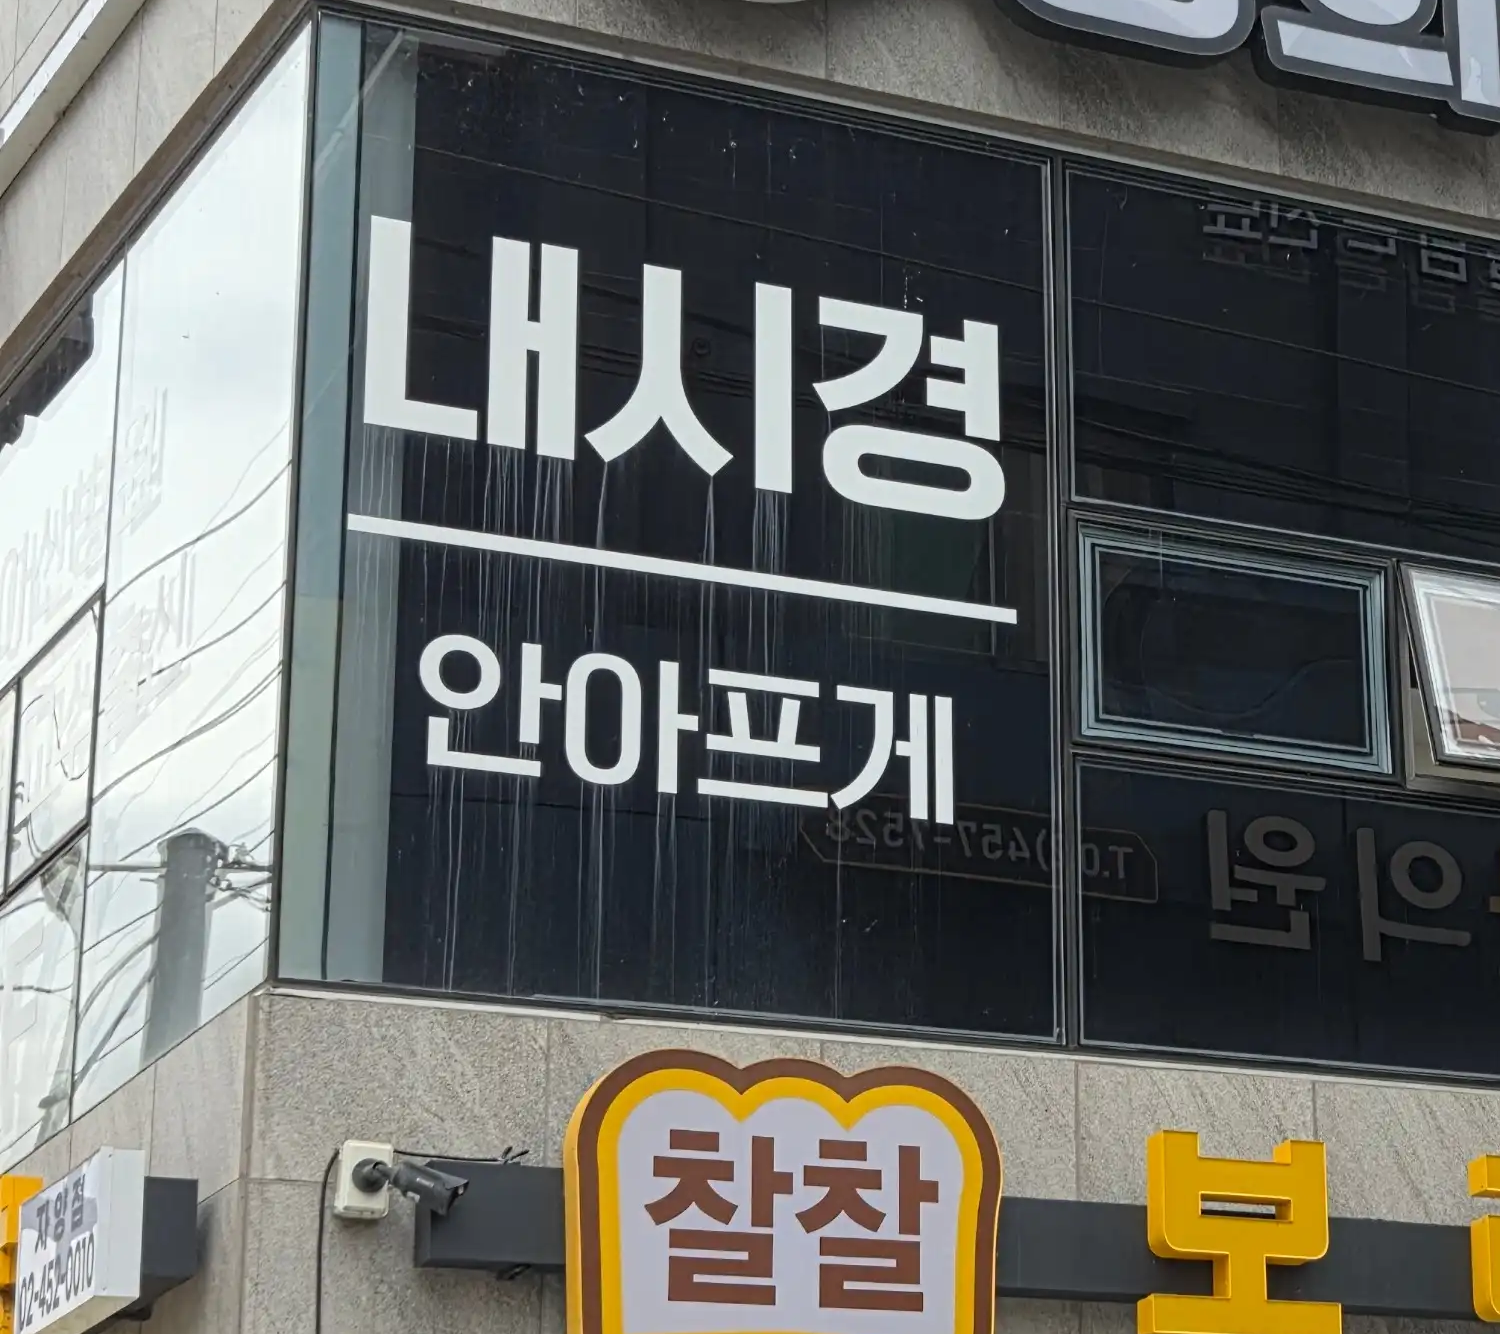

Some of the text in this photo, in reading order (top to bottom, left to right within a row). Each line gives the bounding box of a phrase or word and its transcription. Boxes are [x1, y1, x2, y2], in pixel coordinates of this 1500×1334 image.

[363, 214, 1006, 521] 내시경
[417, 633, 955, 825] 안아프게
[18, 1232, 96, 1333] 02-452-0010
[34, 1173, 87, 1255] 자양점
[643, 1128, 940, 1313] 찰찰
